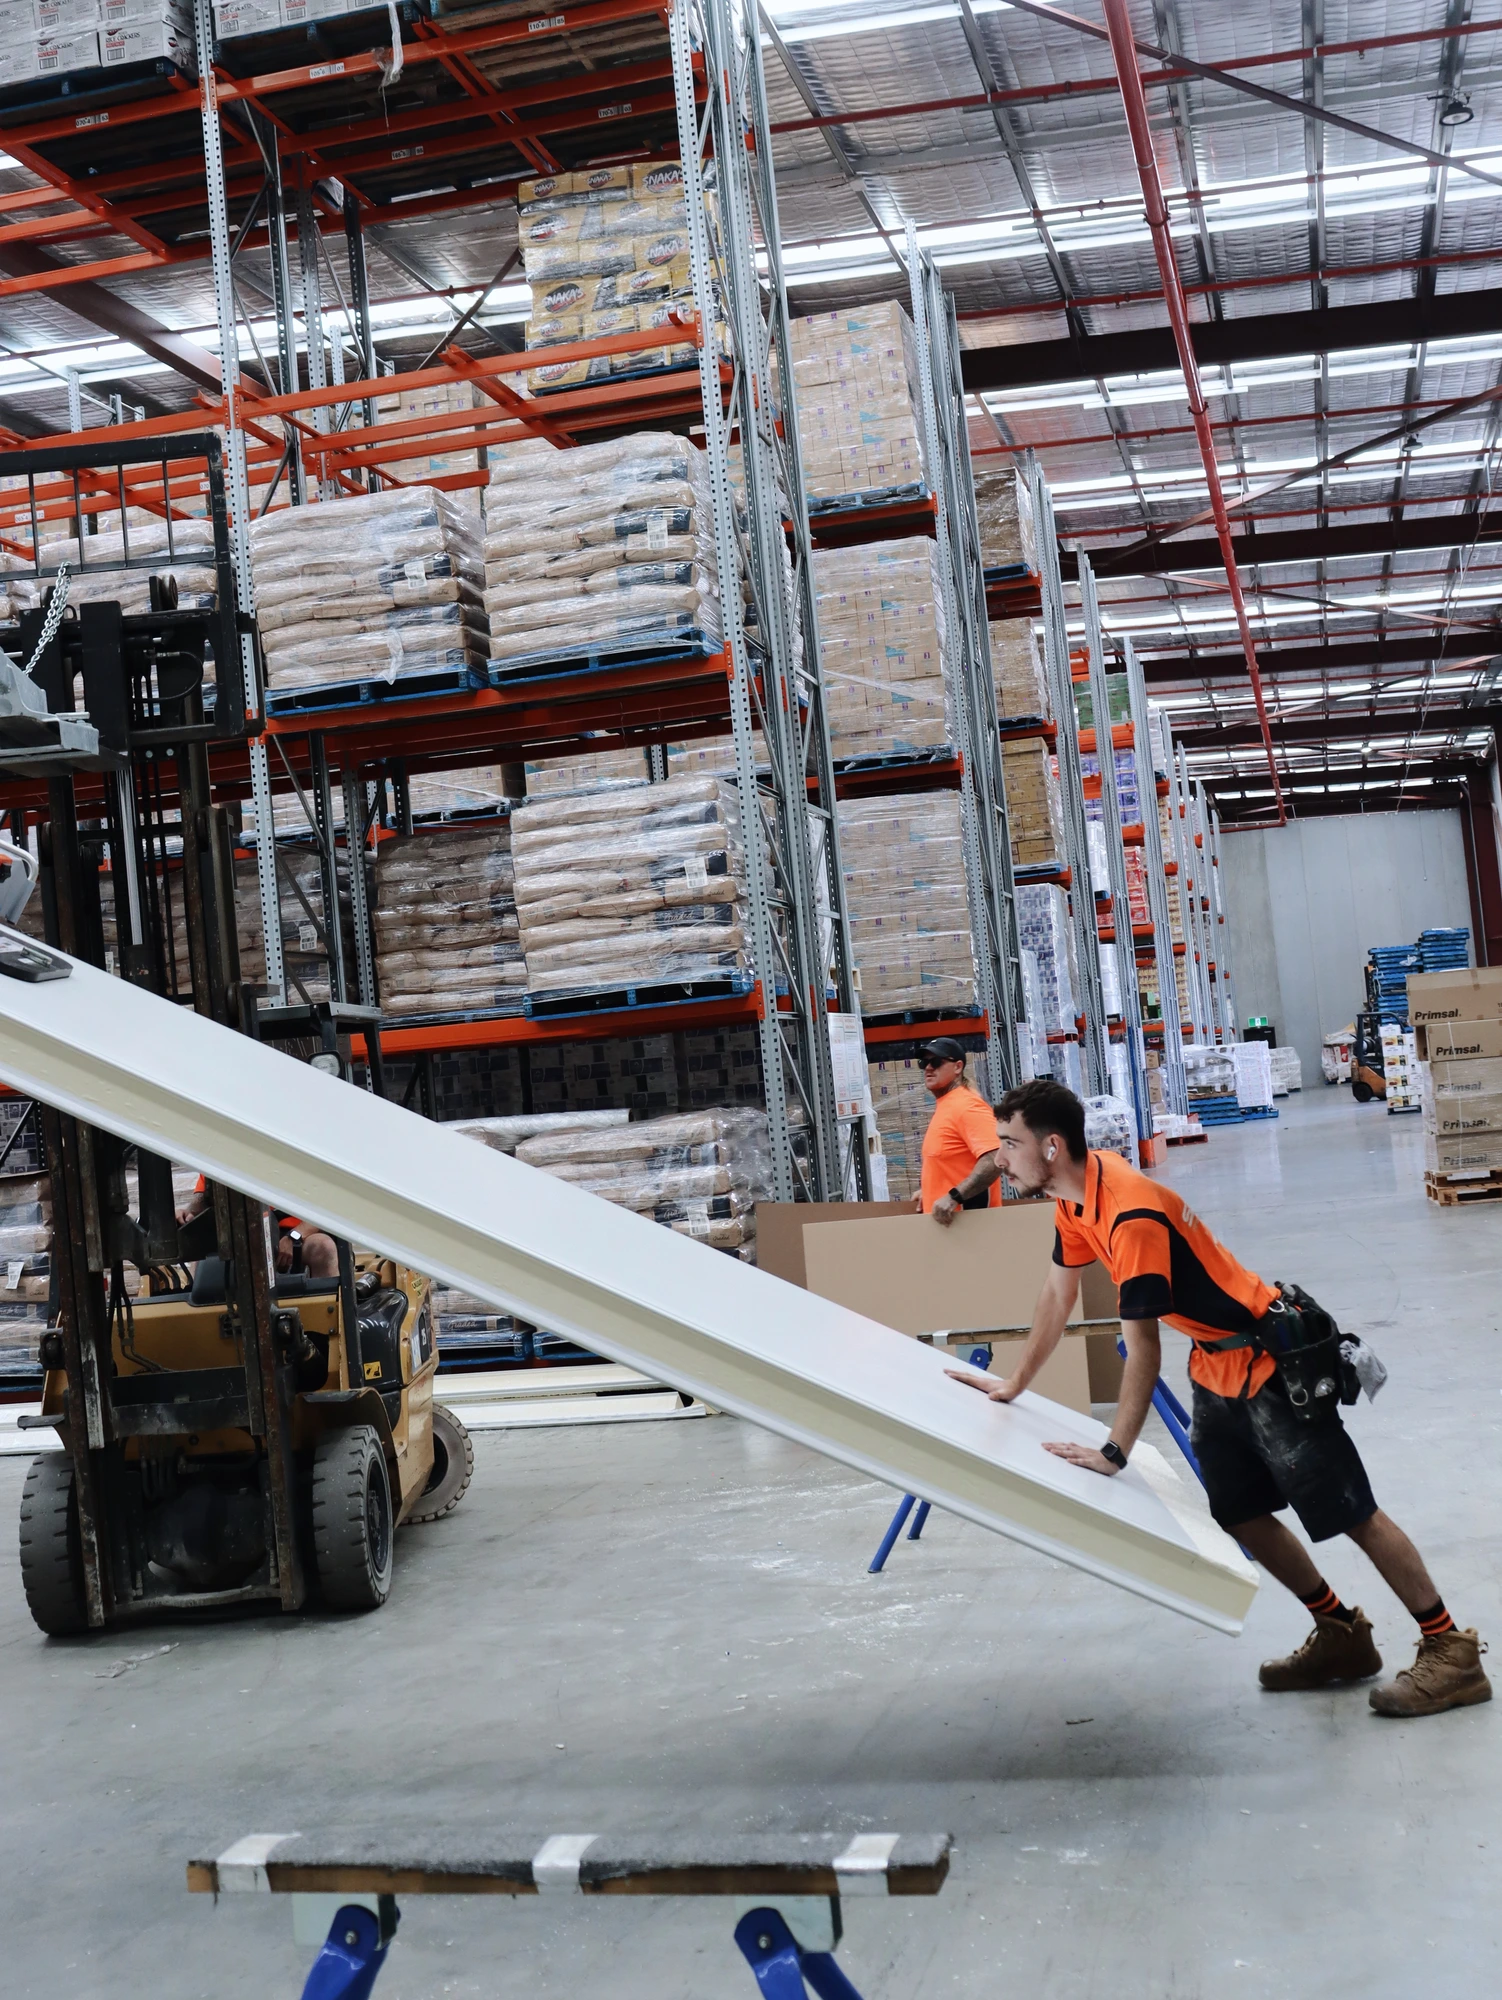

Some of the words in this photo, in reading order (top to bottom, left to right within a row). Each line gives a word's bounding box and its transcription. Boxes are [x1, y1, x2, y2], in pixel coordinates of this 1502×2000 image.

[542, 286, 584, 305] SNAKA'S
[1414, 1007, 1462, 1021] Primsal.
[1435, 1043, 1484, 1057] Primsal.
